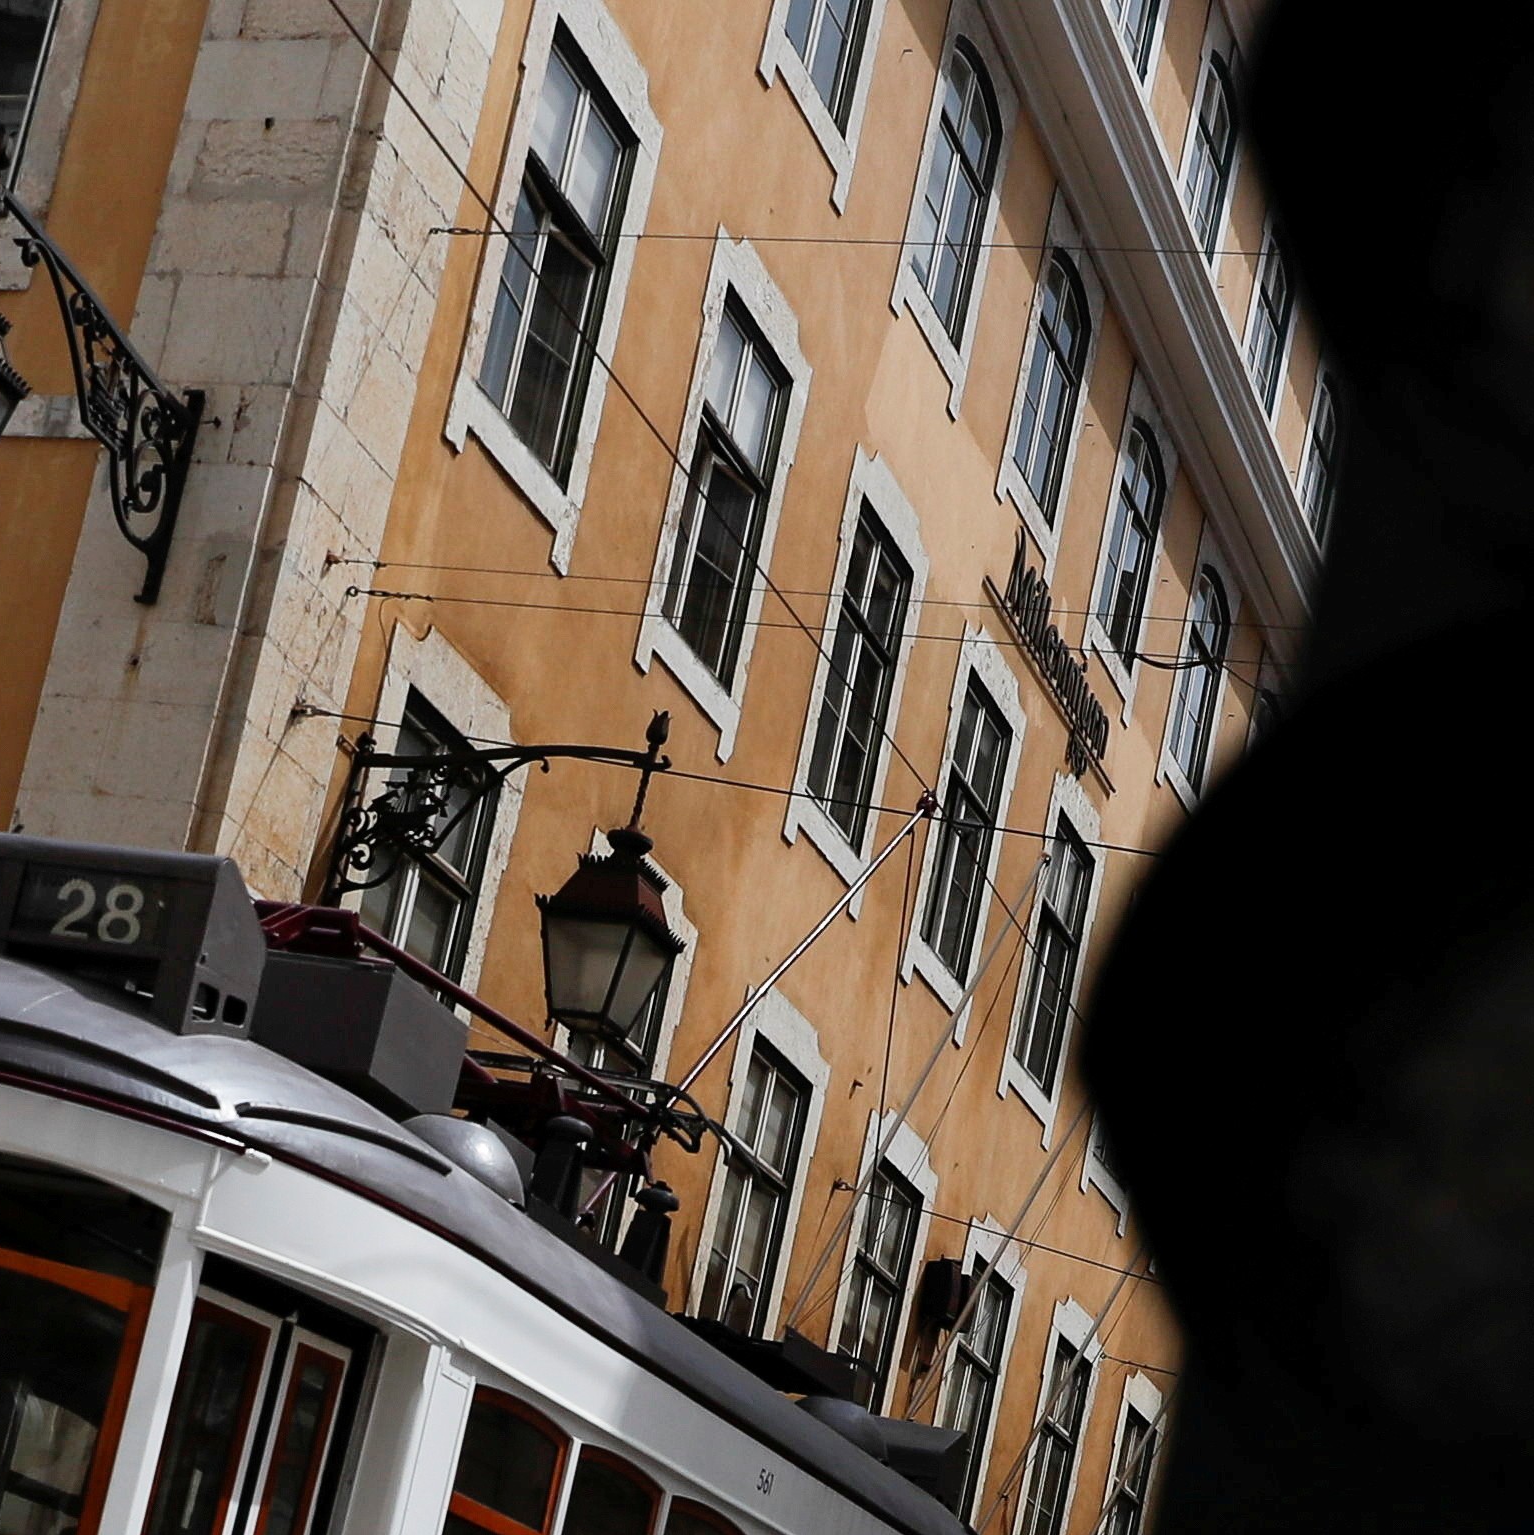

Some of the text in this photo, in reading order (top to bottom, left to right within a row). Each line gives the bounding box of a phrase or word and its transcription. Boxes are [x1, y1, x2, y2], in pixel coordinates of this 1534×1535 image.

[1005, 526, 1108, 760] Millennium
[49, 877, 146, 945] 28
[757, 1468, 774, 1496] 561
